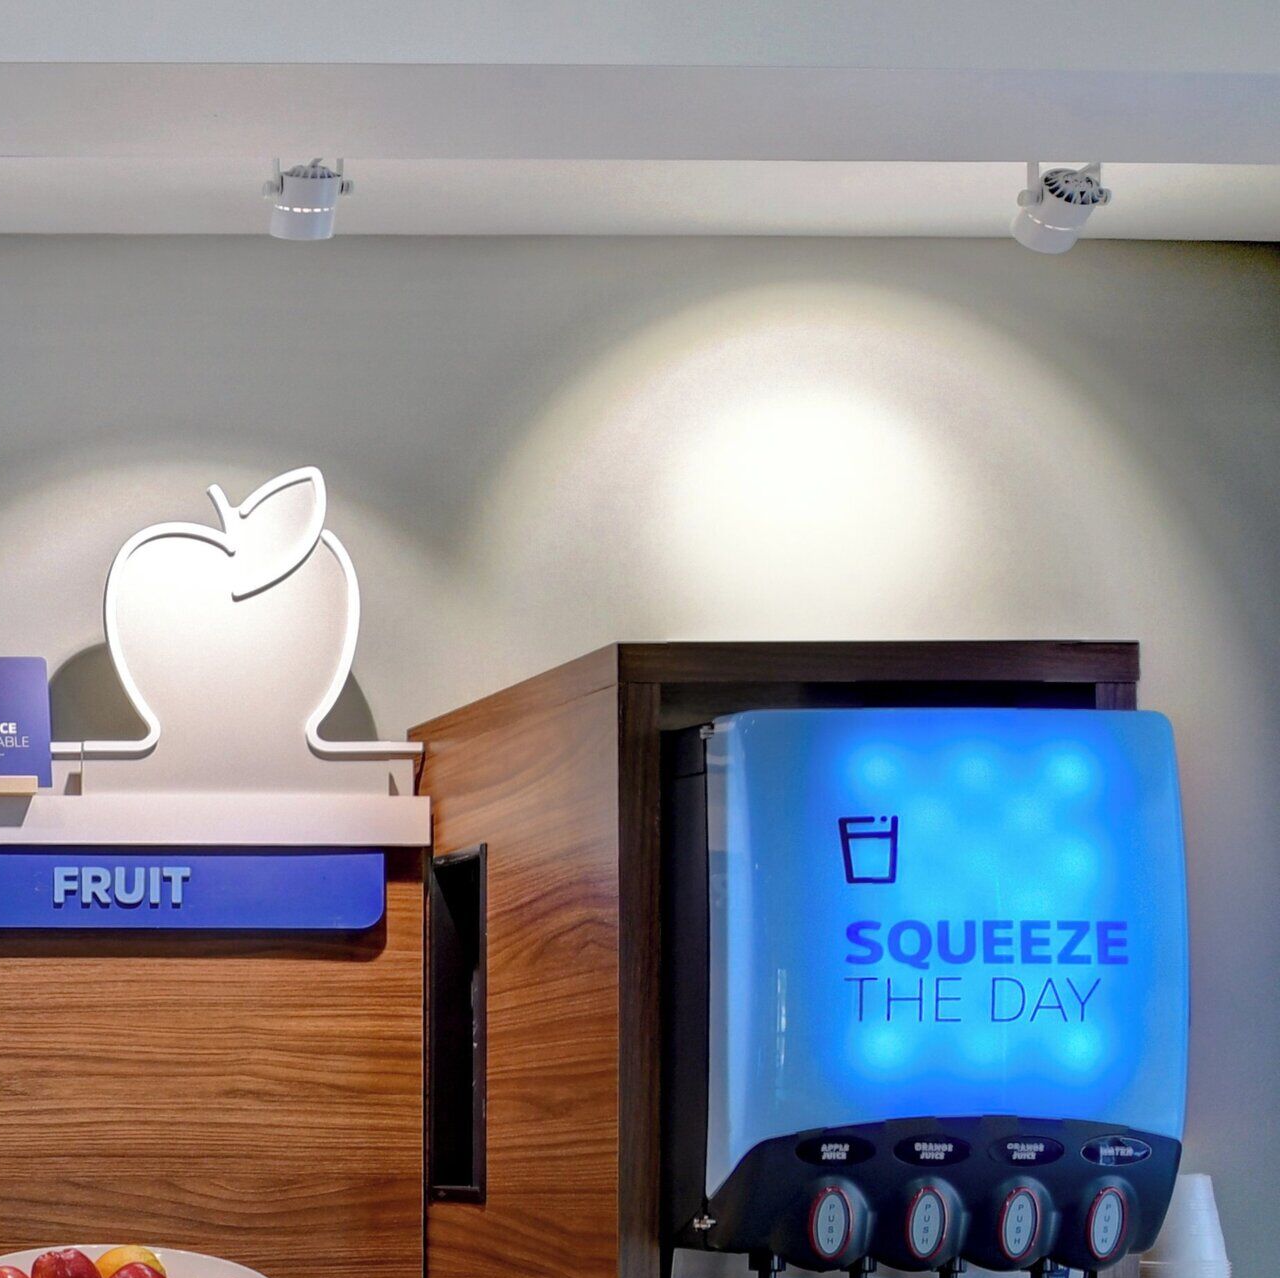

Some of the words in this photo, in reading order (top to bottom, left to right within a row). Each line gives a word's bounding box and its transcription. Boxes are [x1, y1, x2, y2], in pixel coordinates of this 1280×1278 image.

[52, 865, 193, 906] FRUIT
[844, 919, 1130, 970] SQUEEZE
[844, 975, 963, 1023] THE
[990, 975, 1104, 1023] DAY
[820, 1143, 850, 1152] APPLE
[822, 1151, 847, 1160] JUICE
[914, 1142, 954, 1152] ORANGE
[920, 1151, 945, 1160] JUICE
[1006, 1142, 1045, 1152] ORANGE
[1012, 1151, 1037, 1160] JUICE
[826, 1204, 836, 1245] PUSH
[921, 1204, 931, 1245] PUSH
[1013, 1204, 1024, 1245] PUSH
[1100, 1204, 1112, 1245] PUSH
